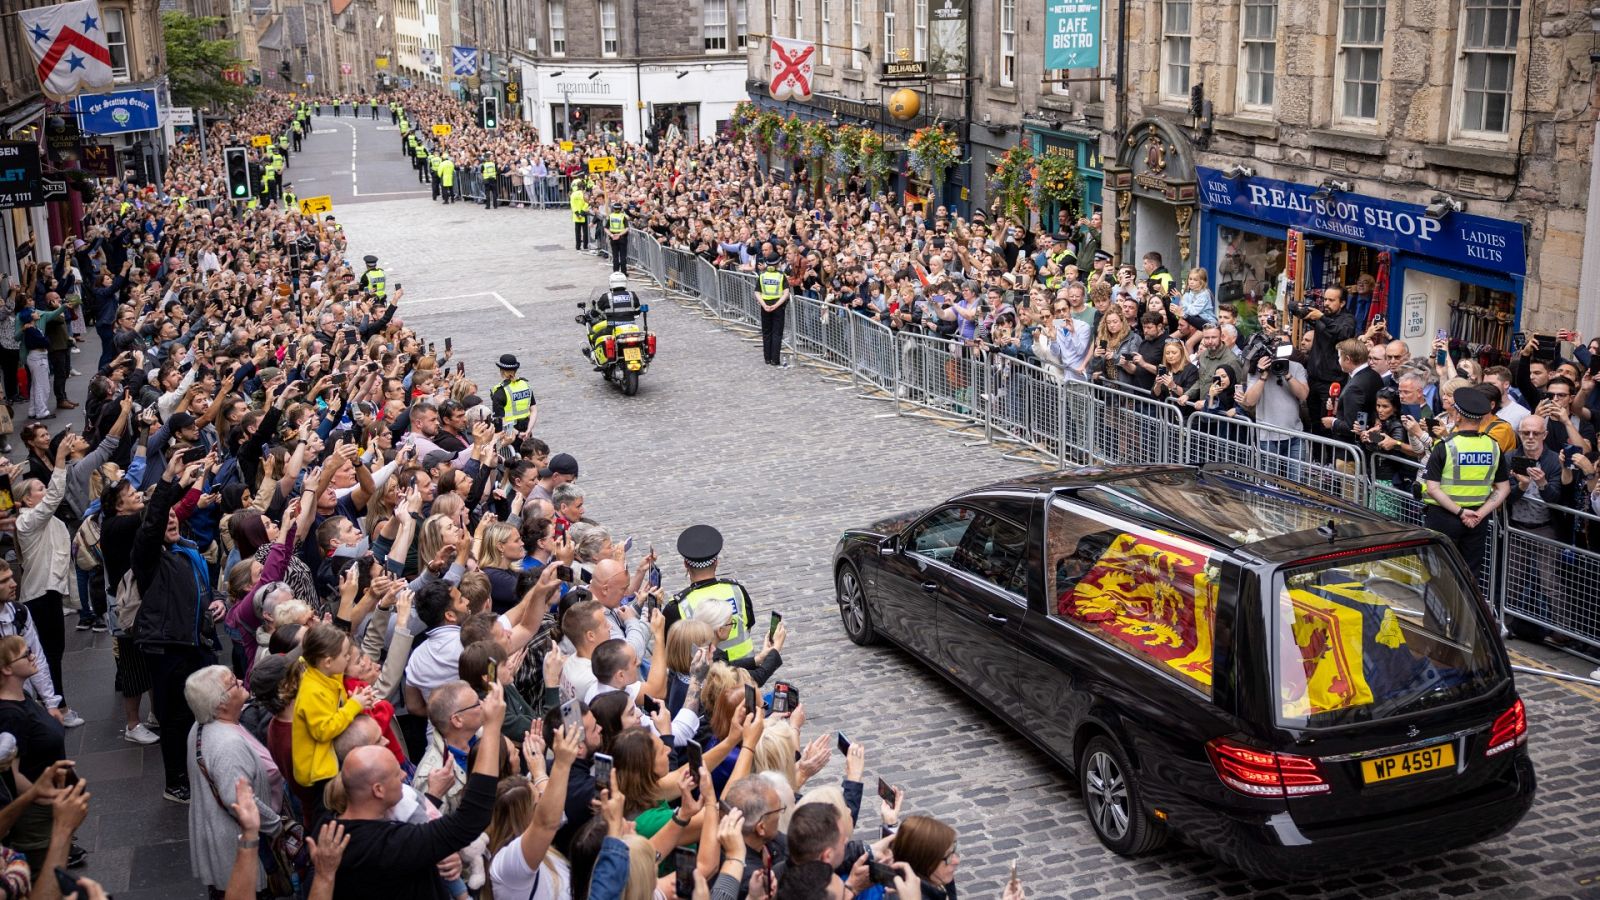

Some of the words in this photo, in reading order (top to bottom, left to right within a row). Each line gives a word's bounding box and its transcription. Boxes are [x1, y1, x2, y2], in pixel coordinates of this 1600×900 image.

[1059, 18, 1087, 33] CAFE
[1053, 33, 1092, 49] BISTRO
[888, 64, 922, 74] BELHAVEN
[557, 78, 610, 94] ragamuffin
[89, 103, 102, 115] The
[103, 96, 128, 108] Scottish
[129, 98, 149, 110] Grocer
[840, 100, 866, 116] WORLD'S
[867, 106, 880, 119] END
[1208, 181, 1228, 193] KIDS
[15, 192, 32, 201] 1111
[1209, 192, 1232, 206] KILTS
[1248, 184, 1313, 213] REAL
[1315, 199, 1359, 222] SCOT
[1363, 206, 1441, 241] SHOP
[1315, 218, 1366, 238] CASHMERE
[1461, 229, 1506, 248] LADIES
[1466, 244, 1503, 262] KILTS
[1412, 317, 1424, 325] FOR
[1411, 325, 1420, 333] £10
[513, 390, 530, 401] POLICE
[1459, 453, 1492, 465] POLICE
[1374, 758, 1396, 779] WP
[1402, 749, 1442, 773] 4597
